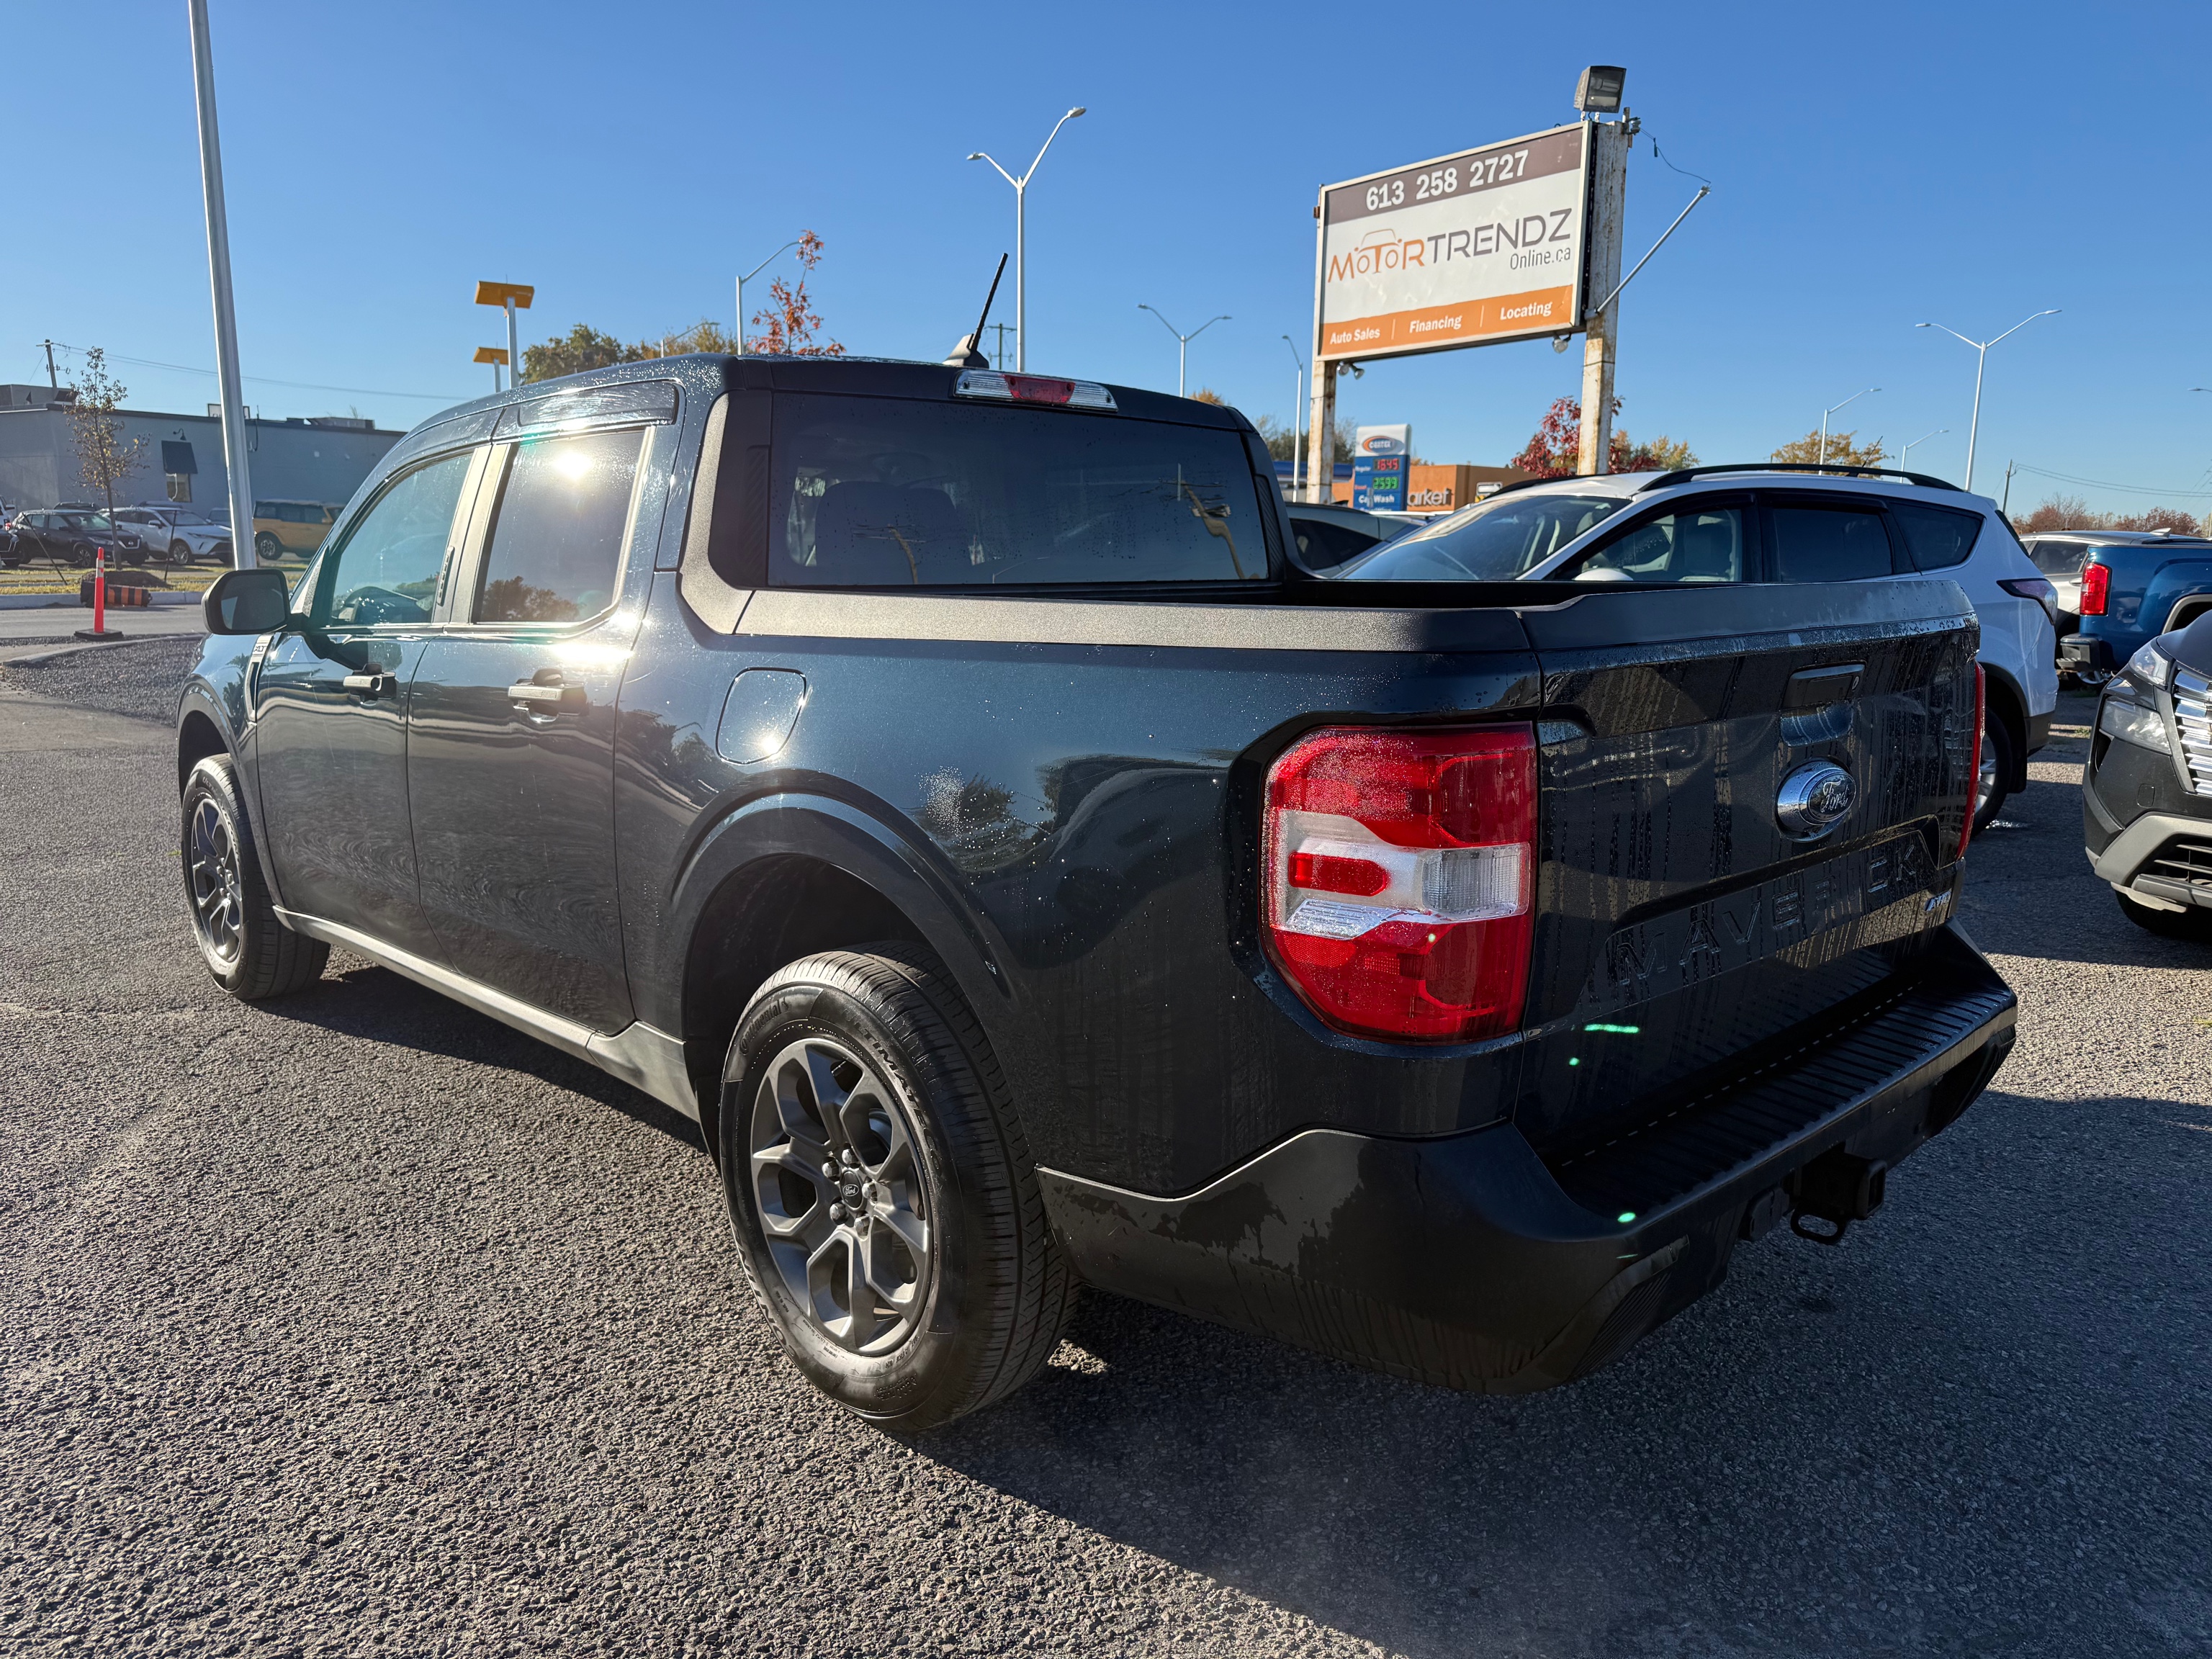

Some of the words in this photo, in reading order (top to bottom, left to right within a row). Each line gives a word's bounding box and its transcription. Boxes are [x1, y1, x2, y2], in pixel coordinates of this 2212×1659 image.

[1366, 181, 1404, 210] 613
[1416, 167, 1457, 200] 258
[1469, 149, 1529, 188] 2727
[1510, 245, 1570, 271] Online.ca
[1330, 331, 1352, 344] Auto
[1354, 327, 1380, 342] Sales
[1409, 315, 1462, 333] Financing
[1500, 301, 1552, 320] Locating
[1358, 494, 1370, 503] Ca
[1373, 493, 1395, 503] Wash
[1407, 488, 1449, 507] arket
[1820, 781, 1848, 813] Ford
[1617, 843, 1917, 986] MAVERICK
[739, 999, 783, 1056] Continental
[845, 1185, 856, 1195] Ford
